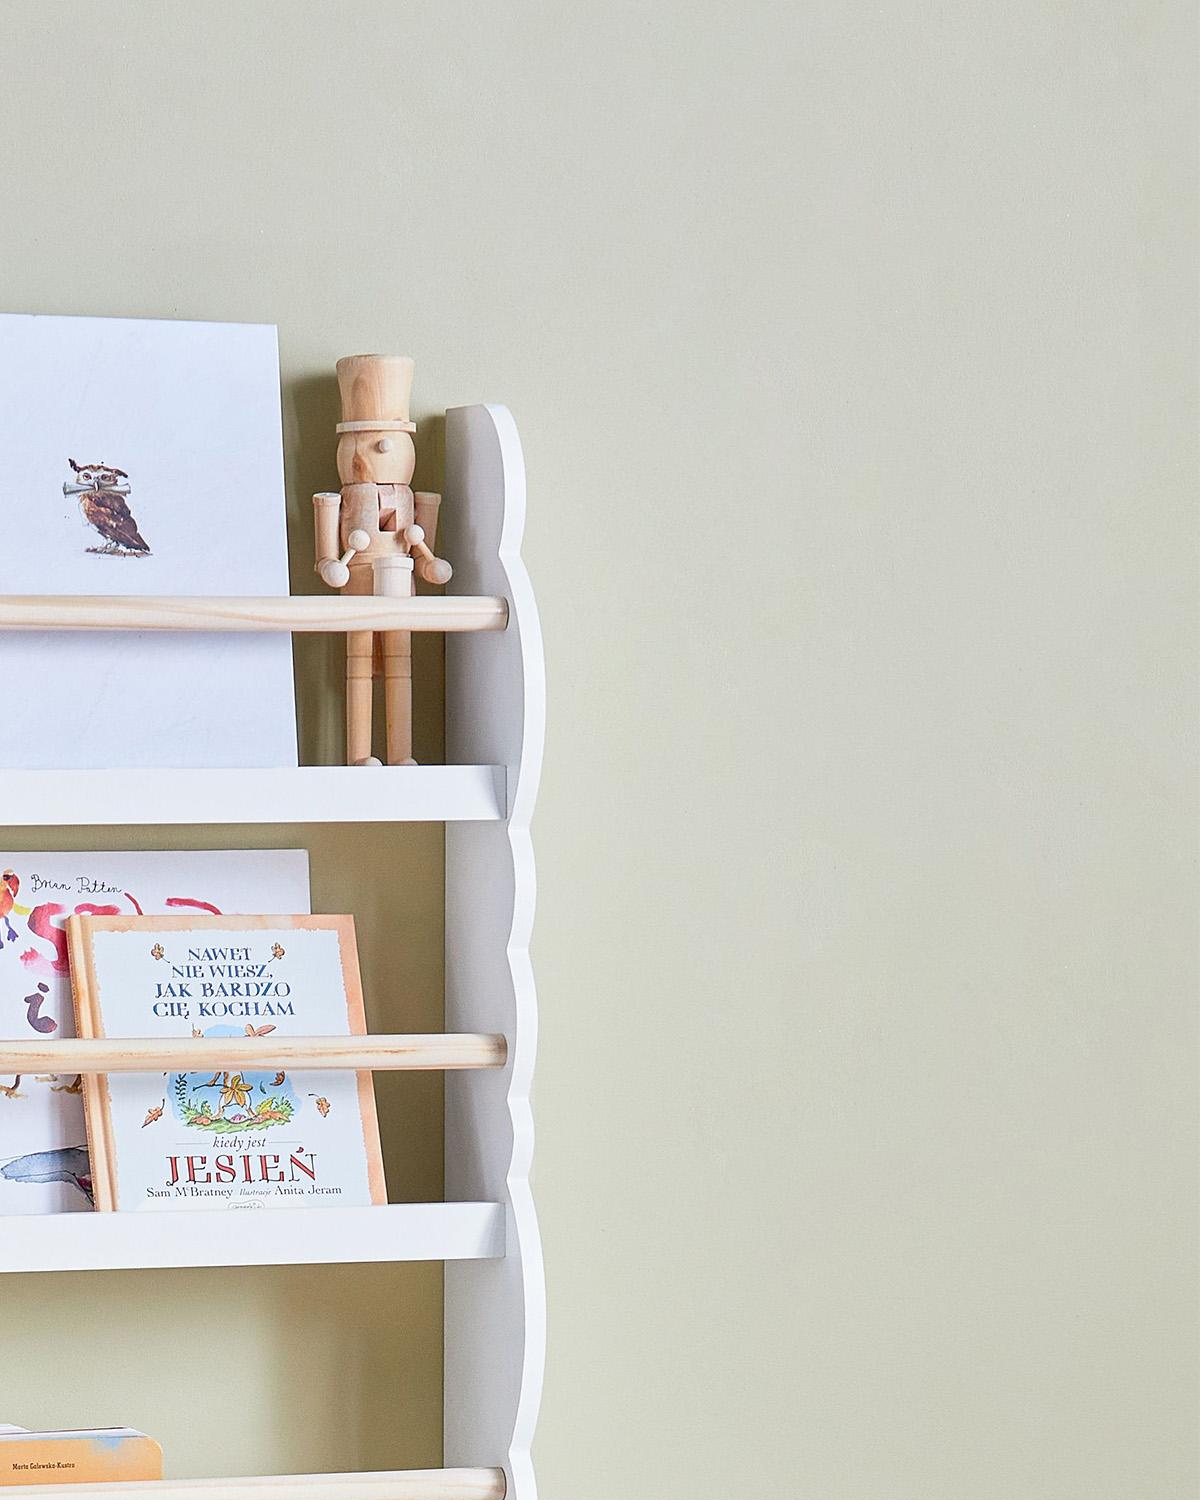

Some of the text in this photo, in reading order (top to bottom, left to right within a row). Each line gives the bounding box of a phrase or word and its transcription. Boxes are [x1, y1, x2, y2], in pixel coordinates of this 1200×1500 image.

[31, 874, 122, 893] Brian Patten
[188, 947, 252, 961] NAWET
[172, 964, 273, 979] NIE WIESZ,
[154, 981, 291, 998] JAK BARDZO
[152, 1001, 296, 1020] CIĘ KOCHAM
[212, 1136, 266, 1152] kiedy jest
[165, 1146, 317, 1187] JESIEŃ
[146, 1187, 171, 1198] Sam
[274, 1185, 304, 1196] Anita
[307, 1184, 342, 1195] Jeram
